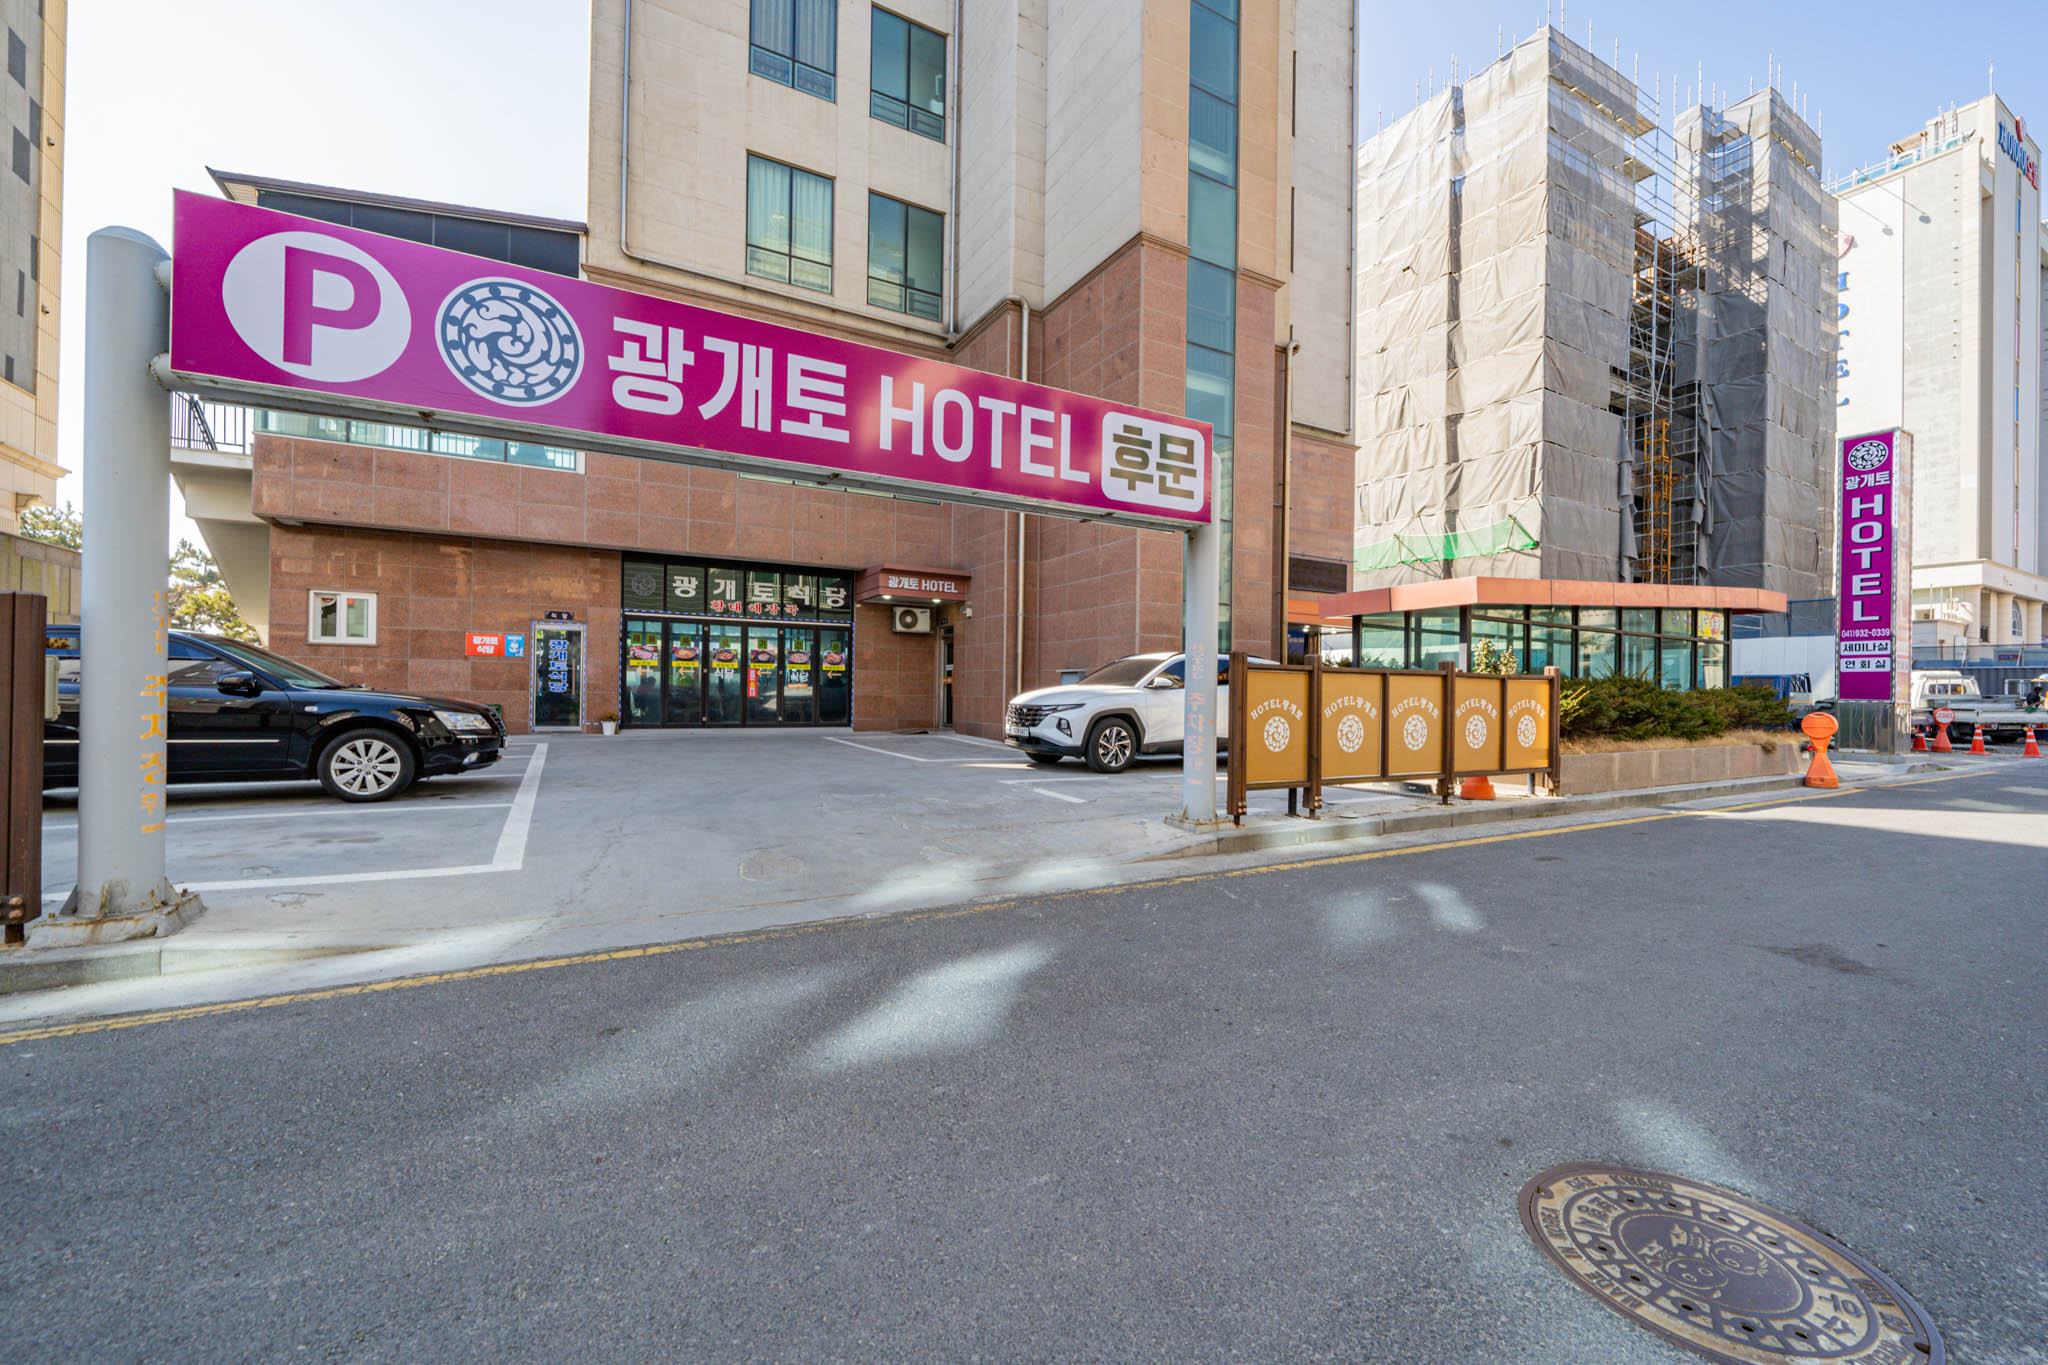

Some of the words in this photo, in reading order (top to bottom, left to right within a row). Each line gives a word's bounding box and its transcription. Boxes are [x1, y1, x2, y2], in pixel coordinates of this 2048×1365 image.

[283, 245, 382, 366] P
[608, 316, 850, 443] 광개토
[879, 375, 1090, 484] HOTEL
[1110, 424, 1198, 500] 후문
[1845, 471, 1891, 490] 광개토
[1851, 494, 1883, 622] HOTEL
[888, 575, 919, 591] 광개토
[921, 579, 959, 594] HOTEL
[1843, 642, 1888, 652] 세미나실
[1541, 1206, 1567, 1242] KOREA
[1558, 1246, 1584, 1261] IN
[1584, 1270, 1644, 1309] MADE
